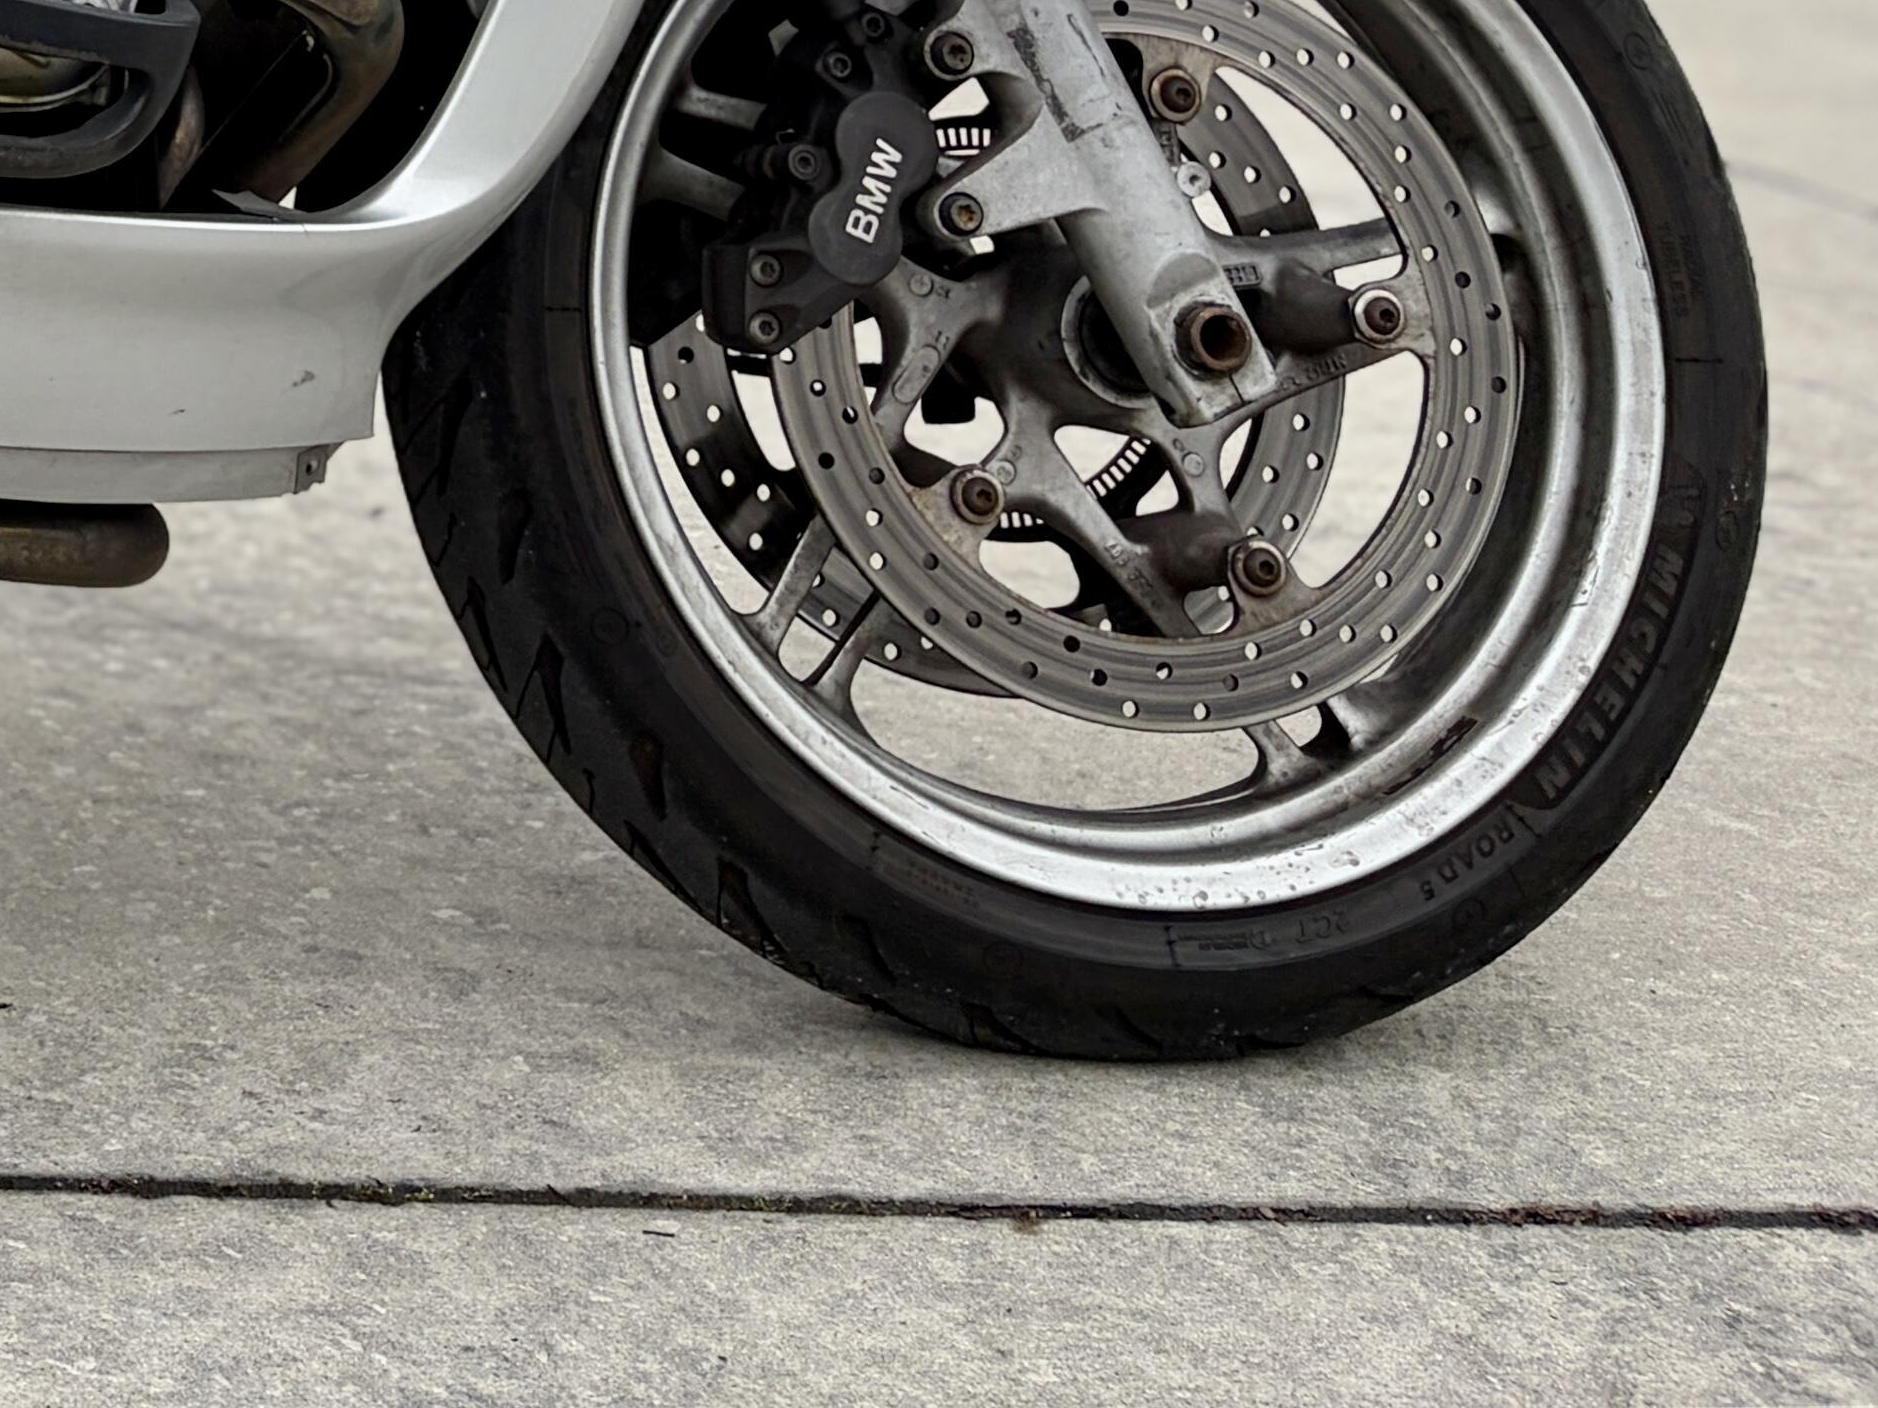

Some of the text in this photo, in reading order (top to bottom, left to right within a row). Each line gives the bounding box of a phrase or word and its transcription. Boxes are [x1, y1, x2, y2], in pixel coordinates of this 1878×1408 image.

[845, 138, 903, 244] BMW
[1531, 543, 1685, 801] MICHELIN
[1438, 820, 1515, 883] ROAD
